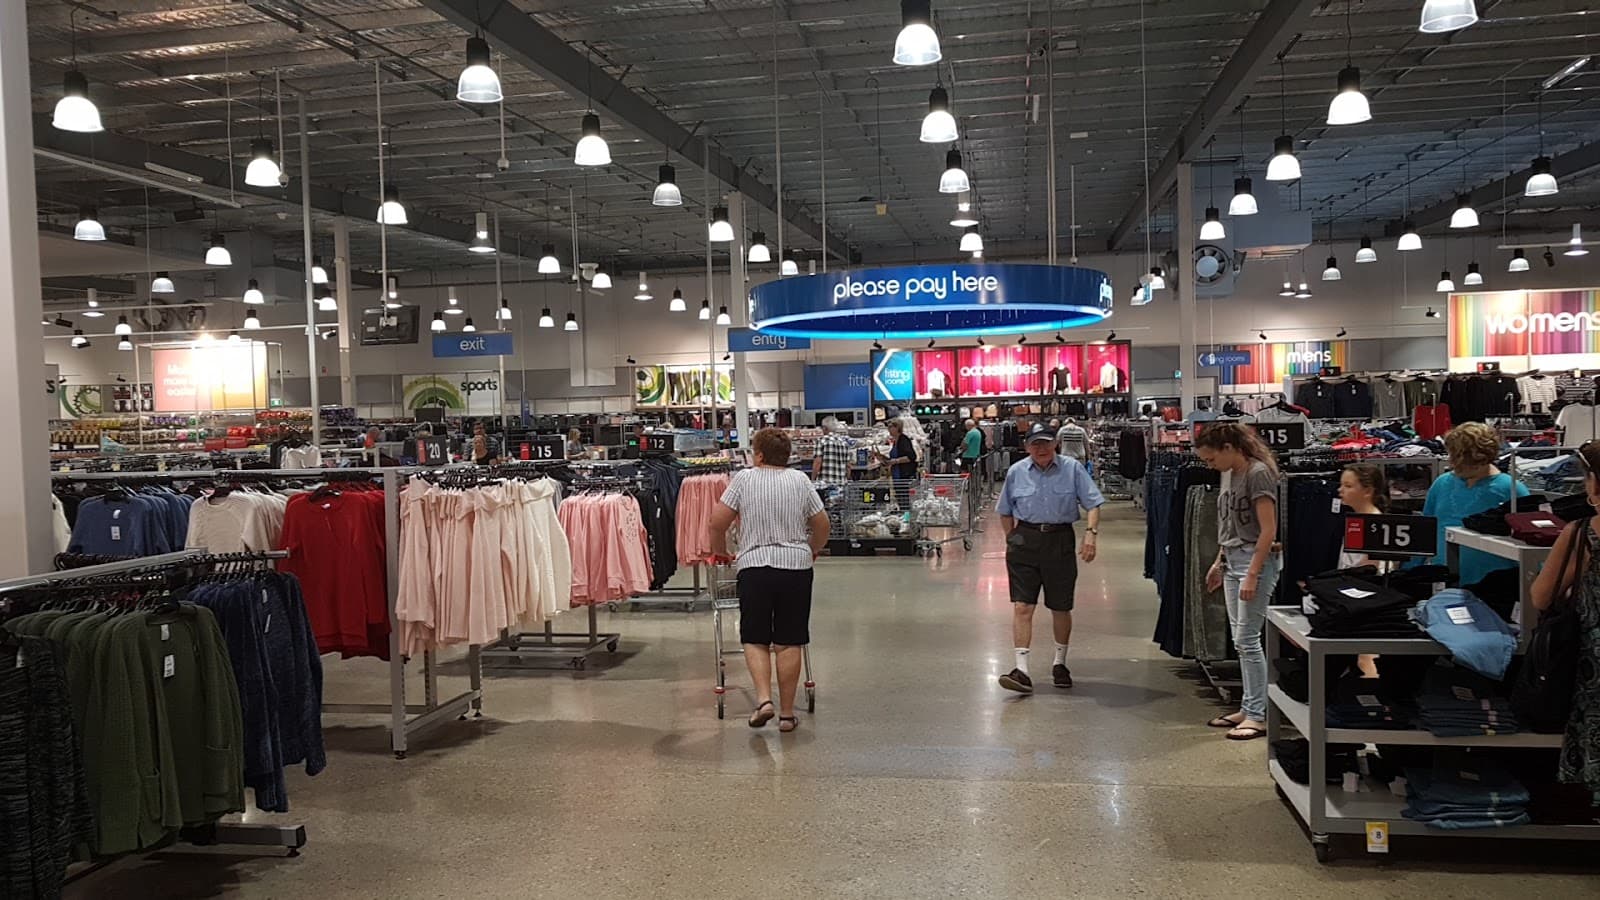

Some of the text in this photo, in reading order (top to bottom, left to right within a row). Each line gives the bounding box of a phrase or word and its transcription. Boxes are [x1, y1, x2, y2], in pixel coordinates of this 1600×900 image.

[833, 270, 998, 305] please pay here
[1487, 311, 1600, 334] womens
[460, 337, 486, 351] exit
[752, 334, 787, 349] entry
[1288, 350, 1332, 363] mens
[885, 368, 911, 381] fitting
[960, 361, 1038, 377] accessories
[460, 378, 498, 396] sports
[1261, 428, 1288, 444] $15
[1370, 523, 1411, 547] $15
